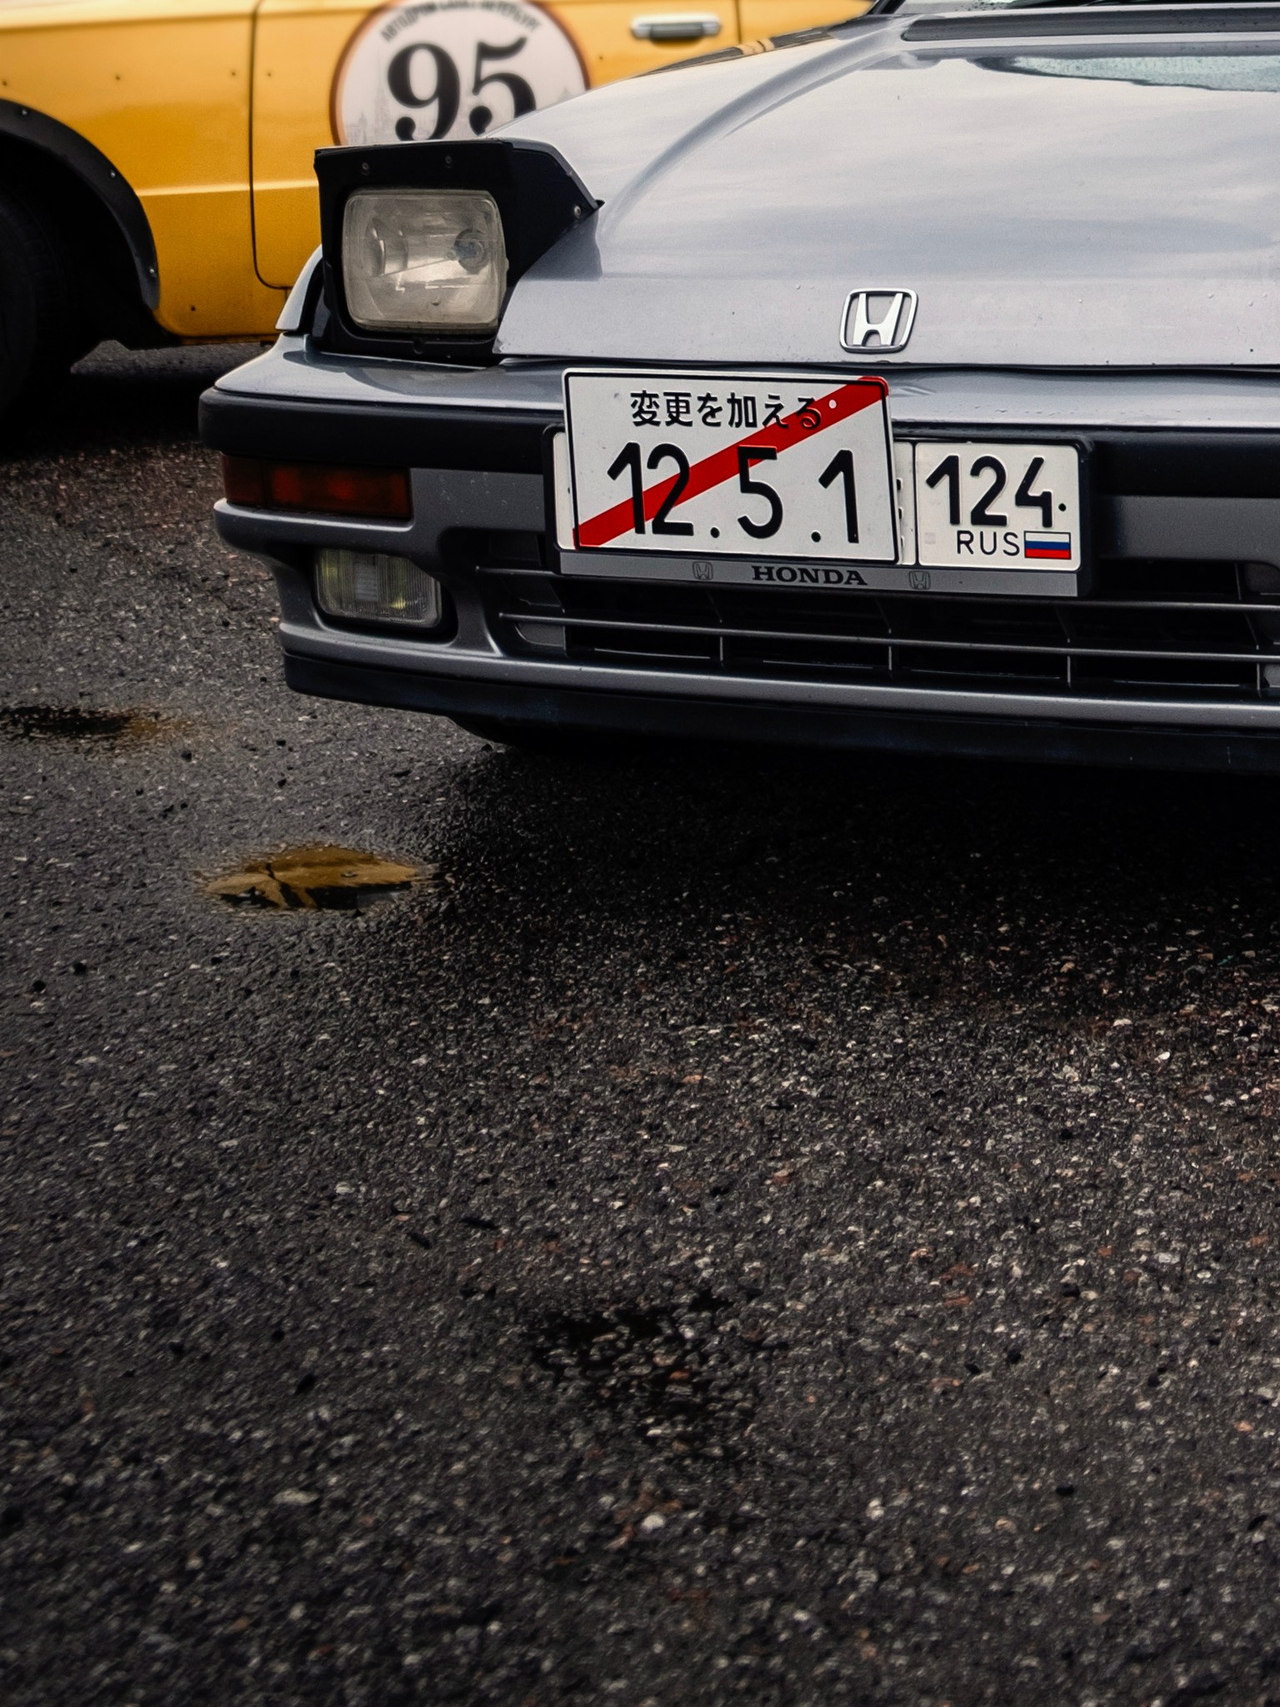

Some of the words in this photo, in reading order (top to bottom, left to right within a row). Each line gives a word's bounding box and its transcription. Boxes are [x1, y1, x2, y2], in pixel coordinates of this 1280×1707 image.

[387, 36, 537, 142] 95
[630, 390, 822, 429] 変更を加える
[926, 455, 1052, 528] 124
[957, 530, 1020, 556] RUS
[752, 565, 868, 586] HONDA
